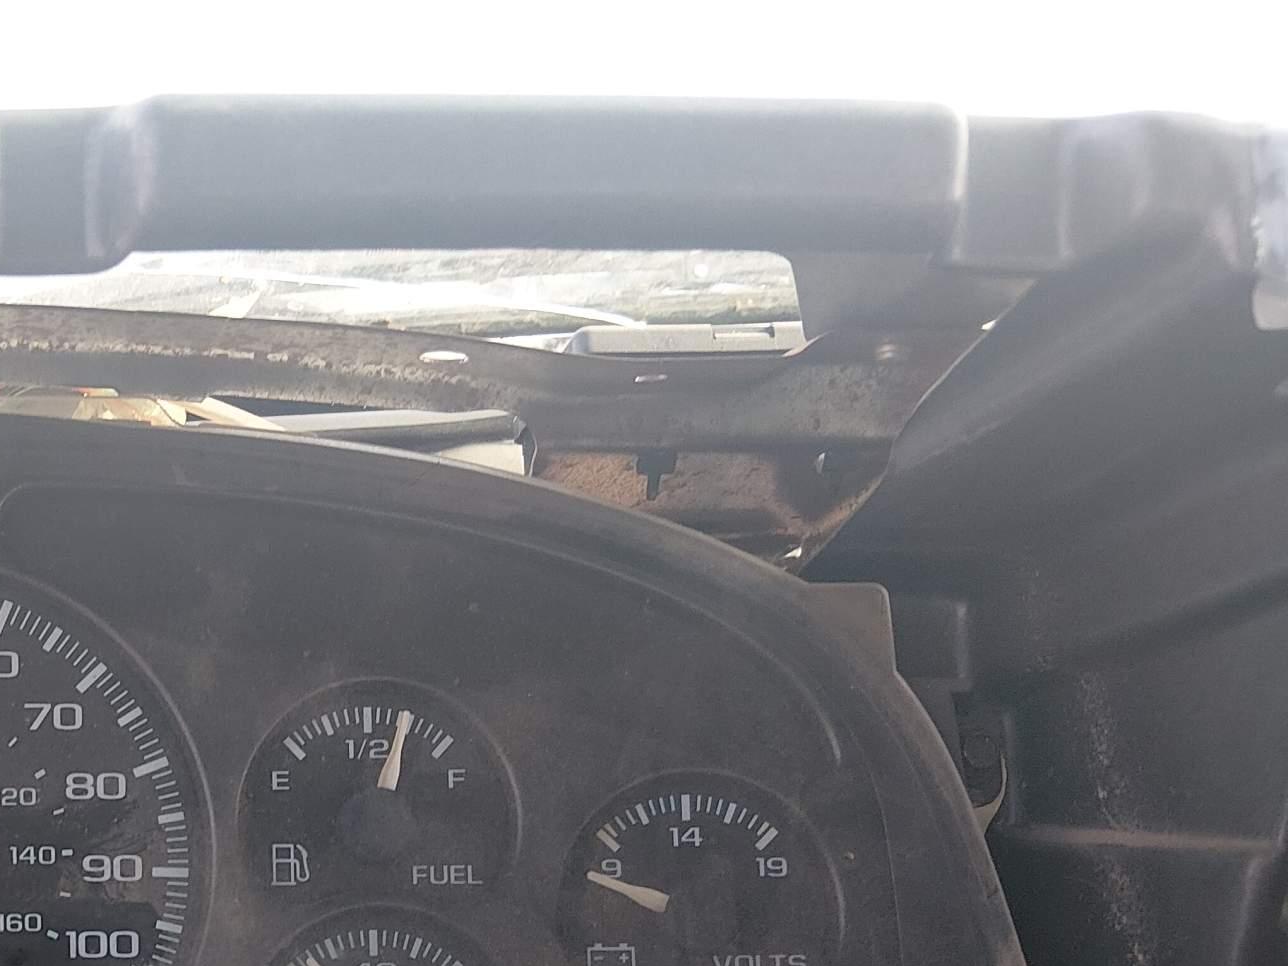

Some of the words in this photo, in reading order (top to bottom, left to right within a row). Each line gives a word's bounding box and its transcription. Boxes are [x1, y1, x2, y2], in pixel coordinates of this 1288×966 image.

[24, 703, 83, 731] 70
[345, 739, 389, 758] 1/2
[65, 773, 127, 800] 80
[271, 772, 289, 790] E
[448, 769, 466, 788] F
[670, 828, 703, 848] 14
[10, 845, 57, 865] 140
[82, 855, 143, 883] 90
[413, 865, 483, 885] FUEL
[602, 860, 622, 878] 9
[757, 857, 788, 878] 19
[66, 931, 140, 958] 100
